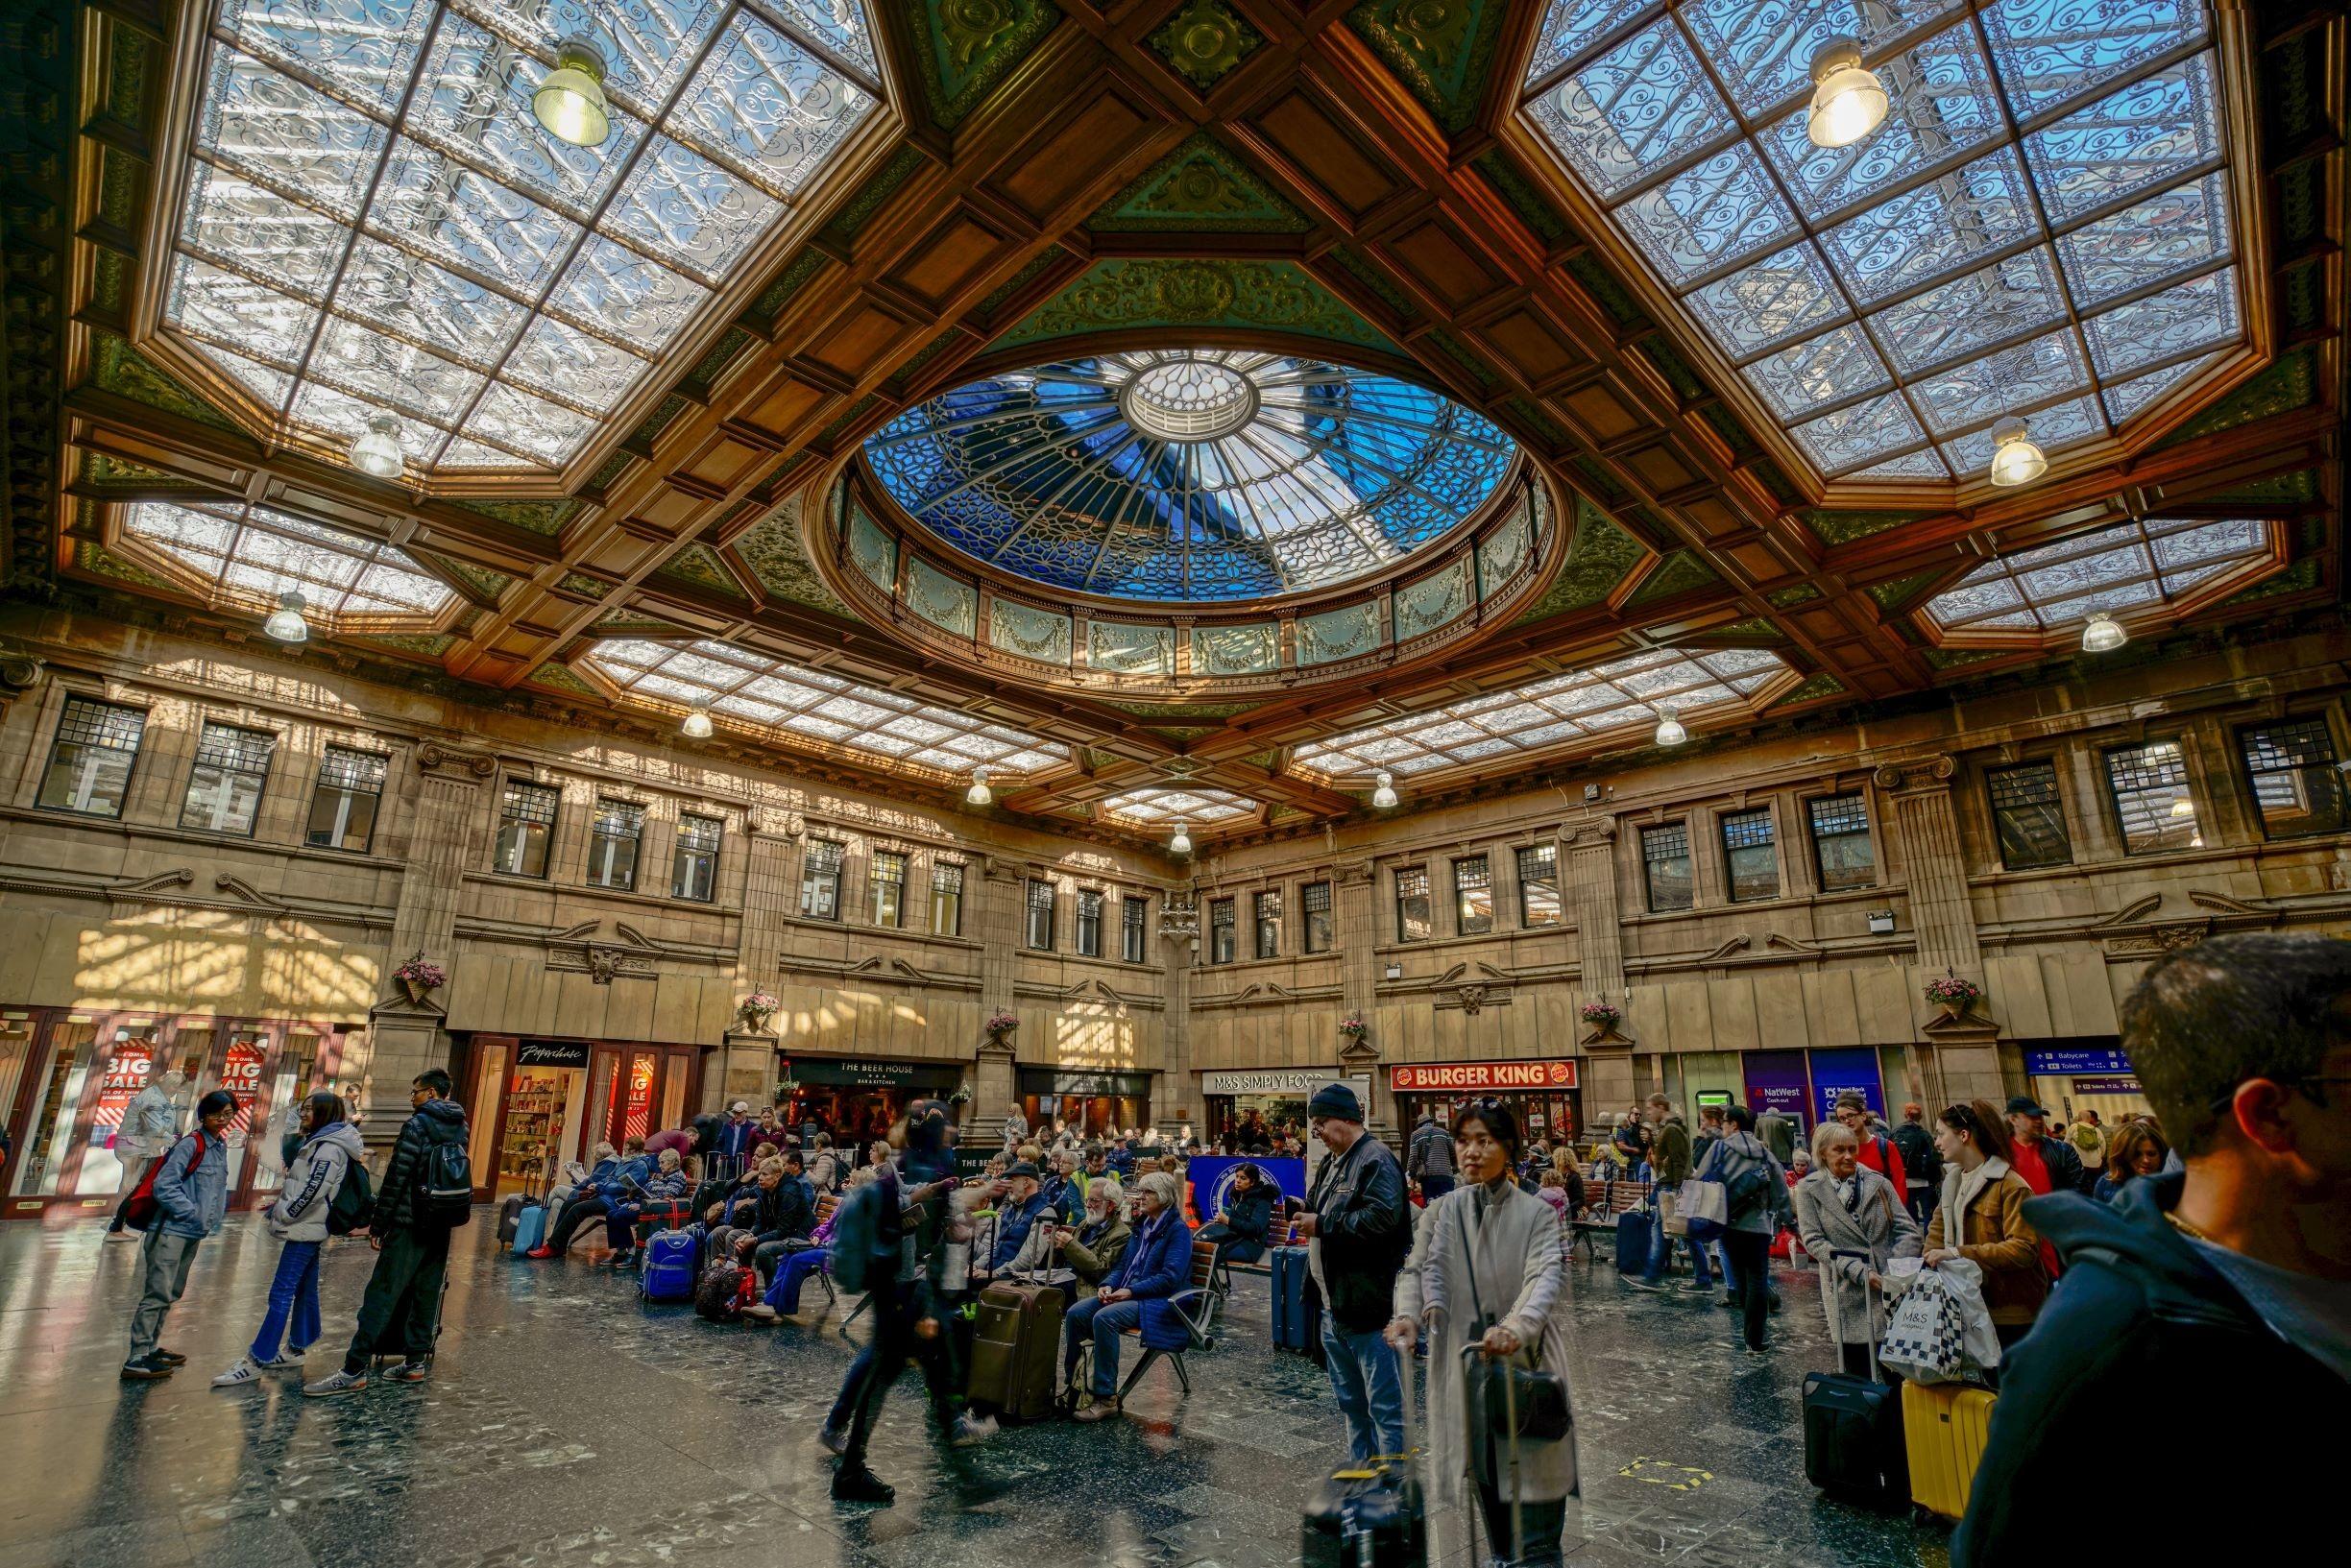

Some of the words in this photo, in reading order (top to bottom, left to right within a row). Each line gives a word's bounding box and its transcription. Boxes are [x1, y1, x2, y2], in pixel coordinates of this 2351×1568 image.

[519, 1045, 582, 1063] Paperchase
[106, 1057, 152, 1074] BIG
[841, 1062, 859, 1071] THE
[861, 1063, 883, 1072] BEER
[885, 1065, 913, 1073] HOUSE
[1215, 1075, 1239, 1090] M&S
[1242, 1074, 1285, 1090] SIMPLY
[1286, 1073, 1323, 1089] FOO
[1416, 1067, 1490, 1086] BURGER
[1493, 1065, 1544, 1084] KING
[221, 1079, 258, 1091] ALE
[1764, 1087, 1801, 1097] NatWest
[961, 1159, 977, 1168] THE
[1903, 1313, 1928, 1324] M&S
